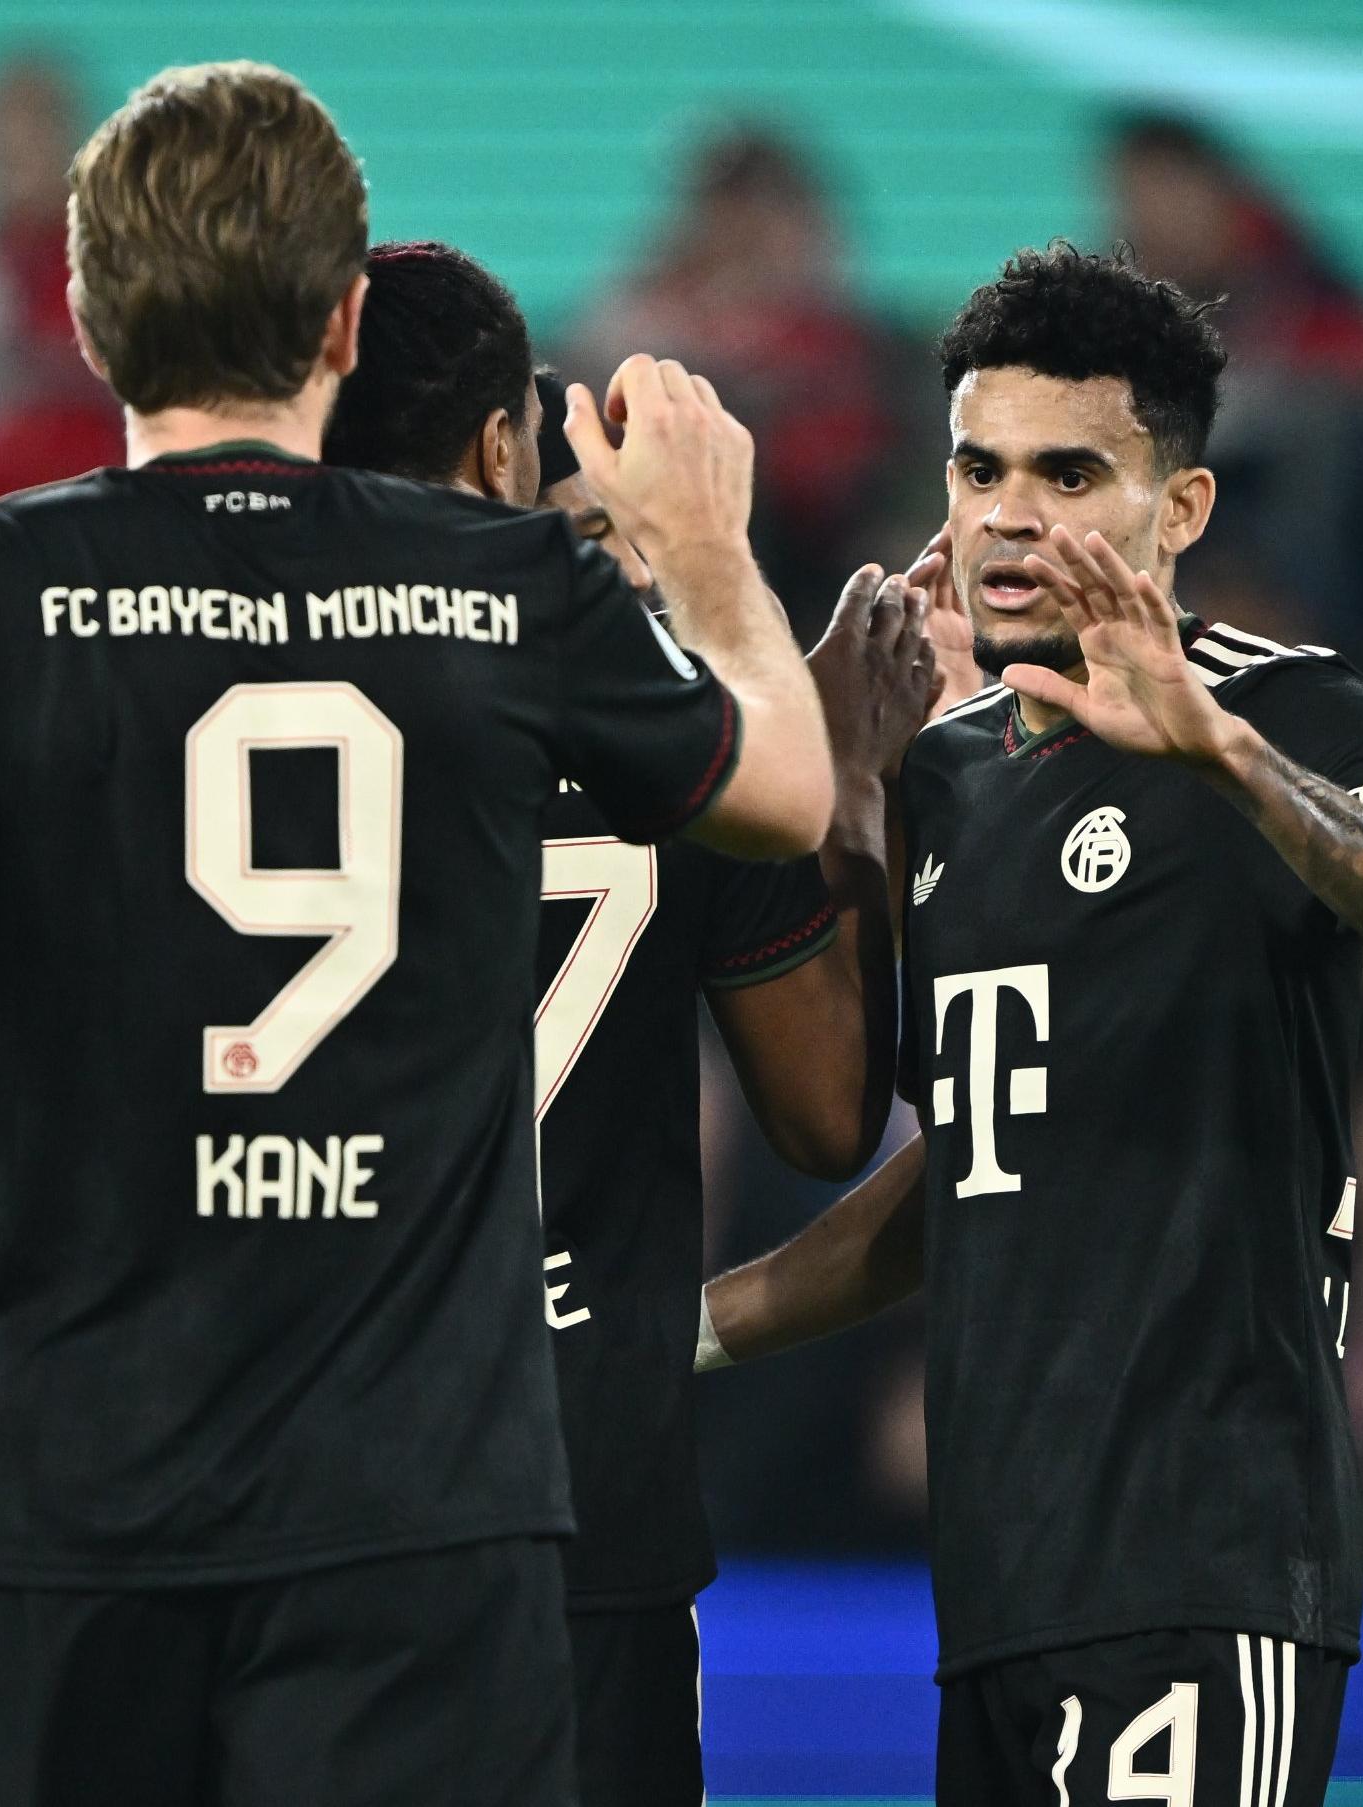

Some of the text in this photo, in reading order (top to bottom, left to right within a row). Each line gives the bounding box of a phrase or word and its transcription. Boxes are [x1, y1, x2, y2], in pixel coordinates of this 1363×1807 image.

[204, 490, 292, 513] FCBM
[40, 583, 520, 646] FC BAYERN MÜNCHEN
[185, 681, 404, 1094] 9
[534, 835, 657, 1222] 7
[196, 1134, 385, 1220] KANE
